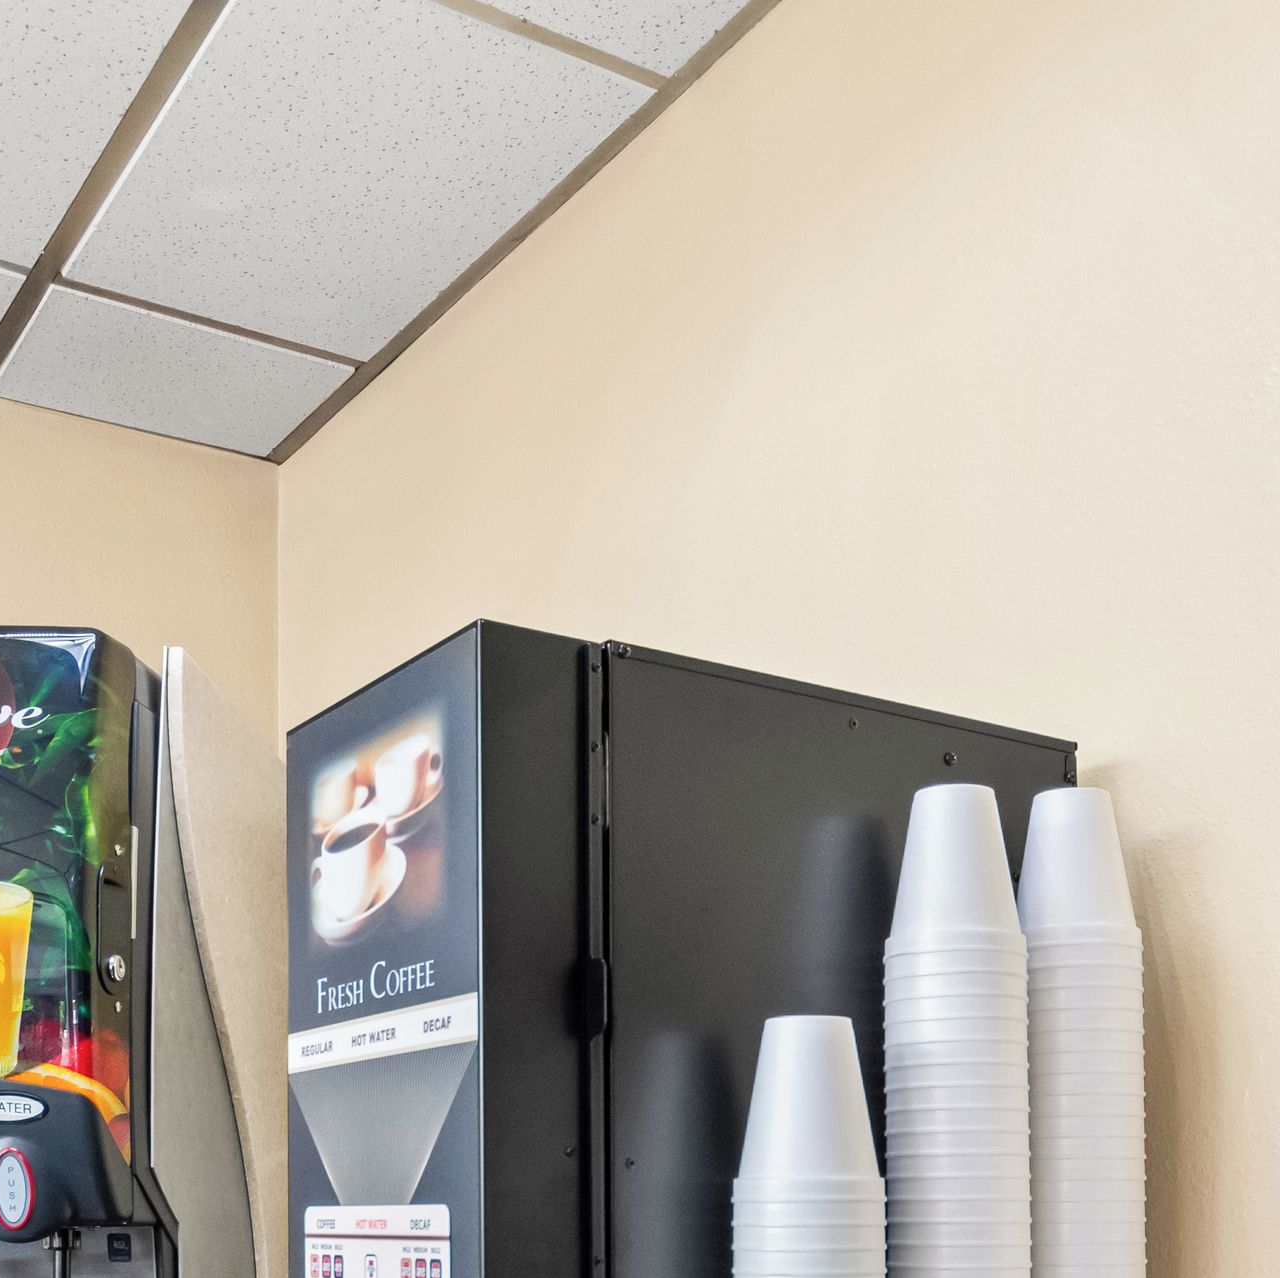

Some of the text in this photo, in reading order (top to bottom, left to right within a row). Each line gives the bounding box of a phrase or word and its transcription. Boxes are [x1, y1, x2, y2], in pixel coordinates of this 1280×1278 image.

[301, 1015, 452, 1058] REGULAR HOT WATER DECAF
[7, 1165, 19, 1213] PUSH
[317, 1219, 336, 1229] COFFEE
[410, 1219, 431, 1230] DECAF
